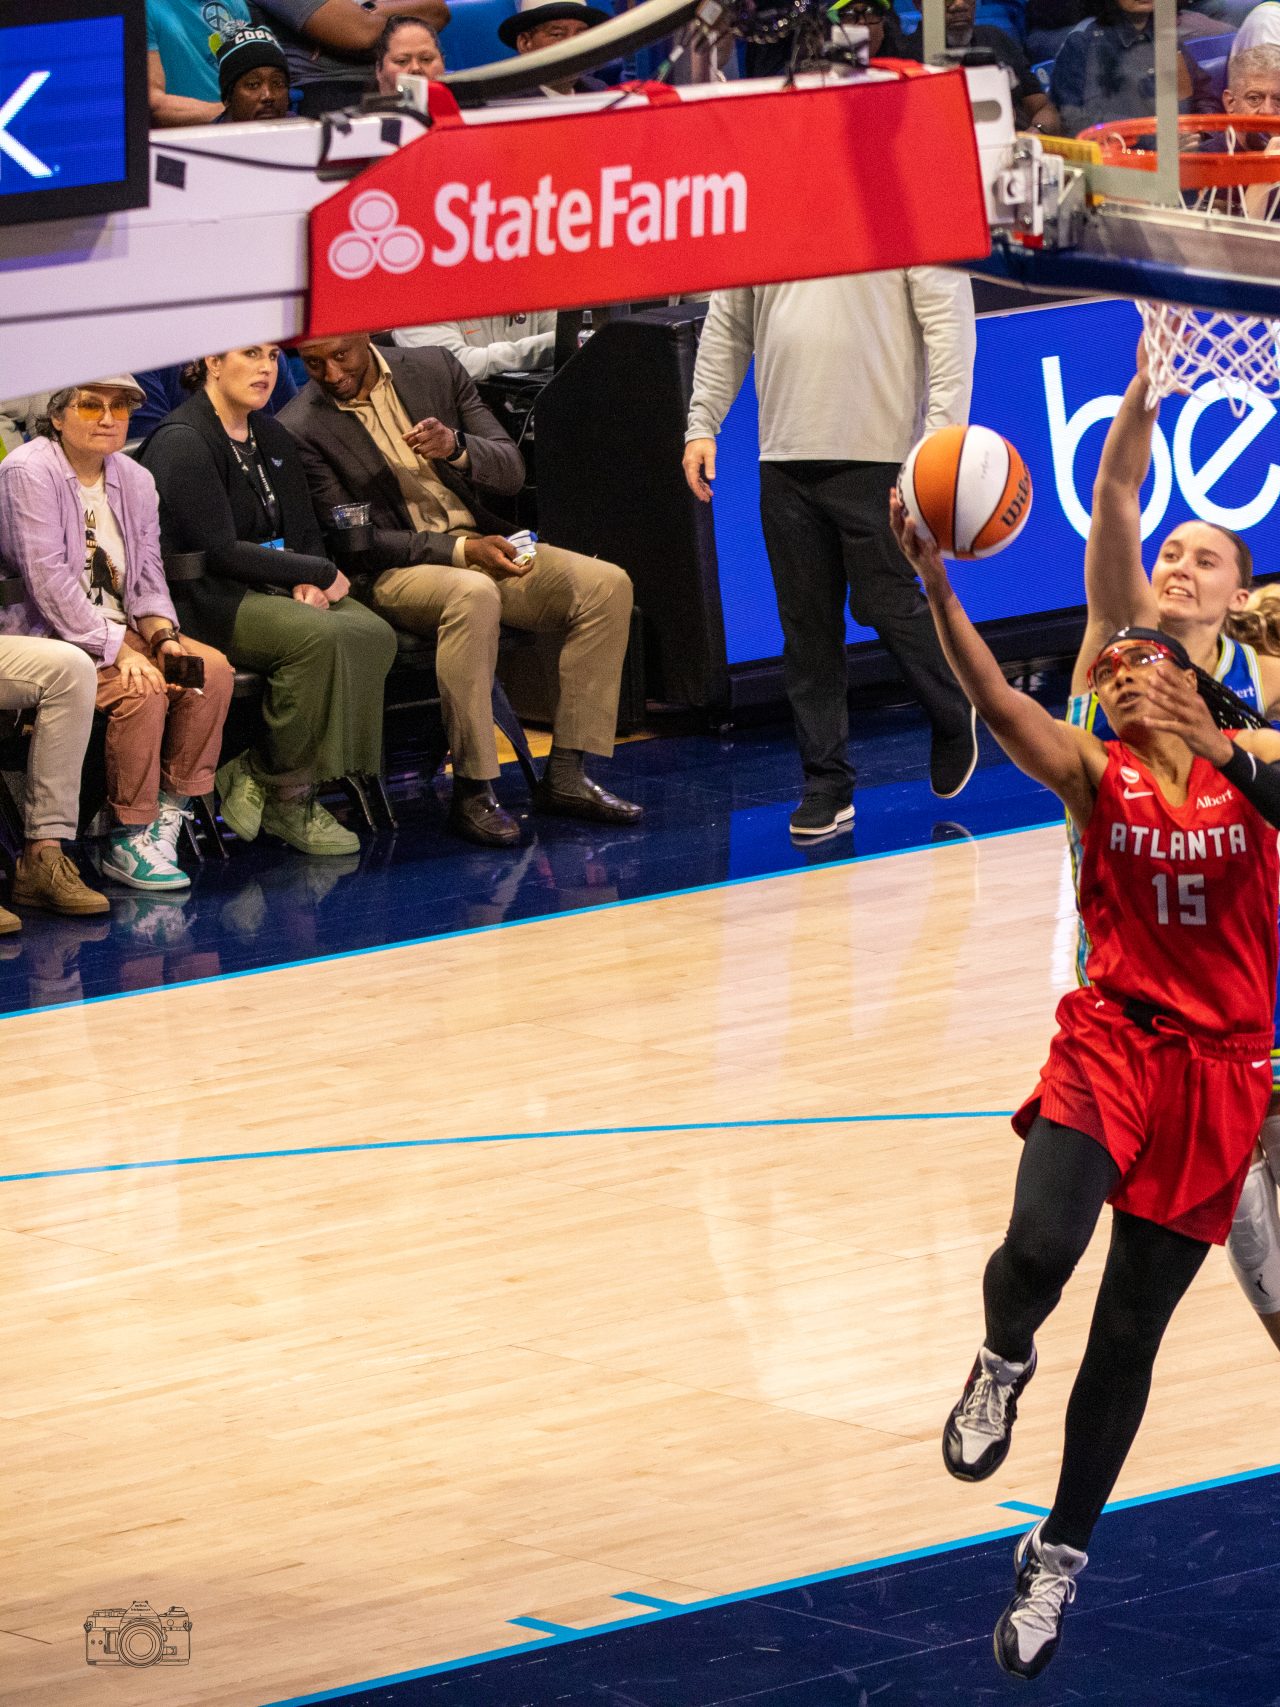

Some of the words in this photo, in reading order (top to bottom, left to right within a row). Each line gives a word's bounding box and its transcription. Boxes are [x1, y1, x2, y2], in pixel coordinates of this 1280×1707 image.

[1195, 788, 1235, 810] Albert
[1109, 822, 1247, 861] ATLANTA
[1151, 872, 1207, 926] 15
